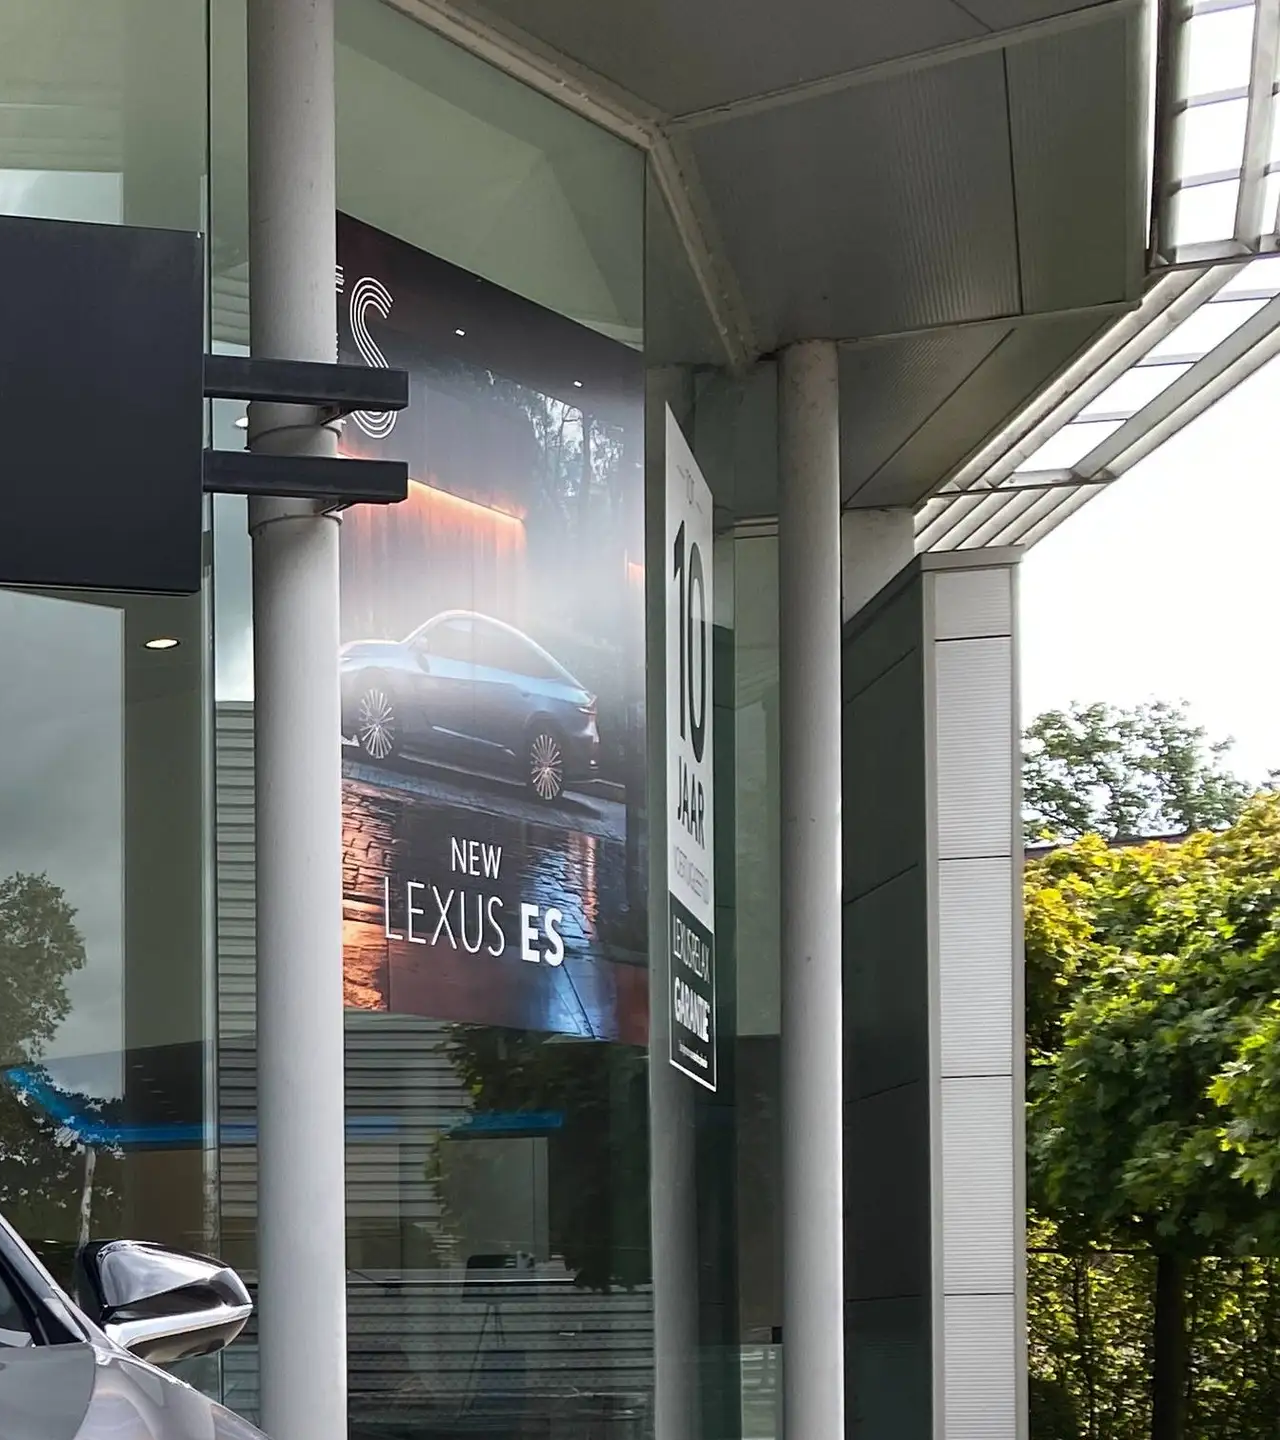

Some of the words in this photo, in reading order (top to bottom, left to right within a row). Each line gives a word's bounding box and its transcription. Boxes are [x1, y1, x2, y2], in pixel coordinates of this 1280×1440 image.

[674, 520, 706, 764] 10
[677, 755, 706, 851] JAAR
[451, 836, 502, 880] NEW
[383, 876, 506, 957] LEXUS
[521, 902, 564, 967] ES
